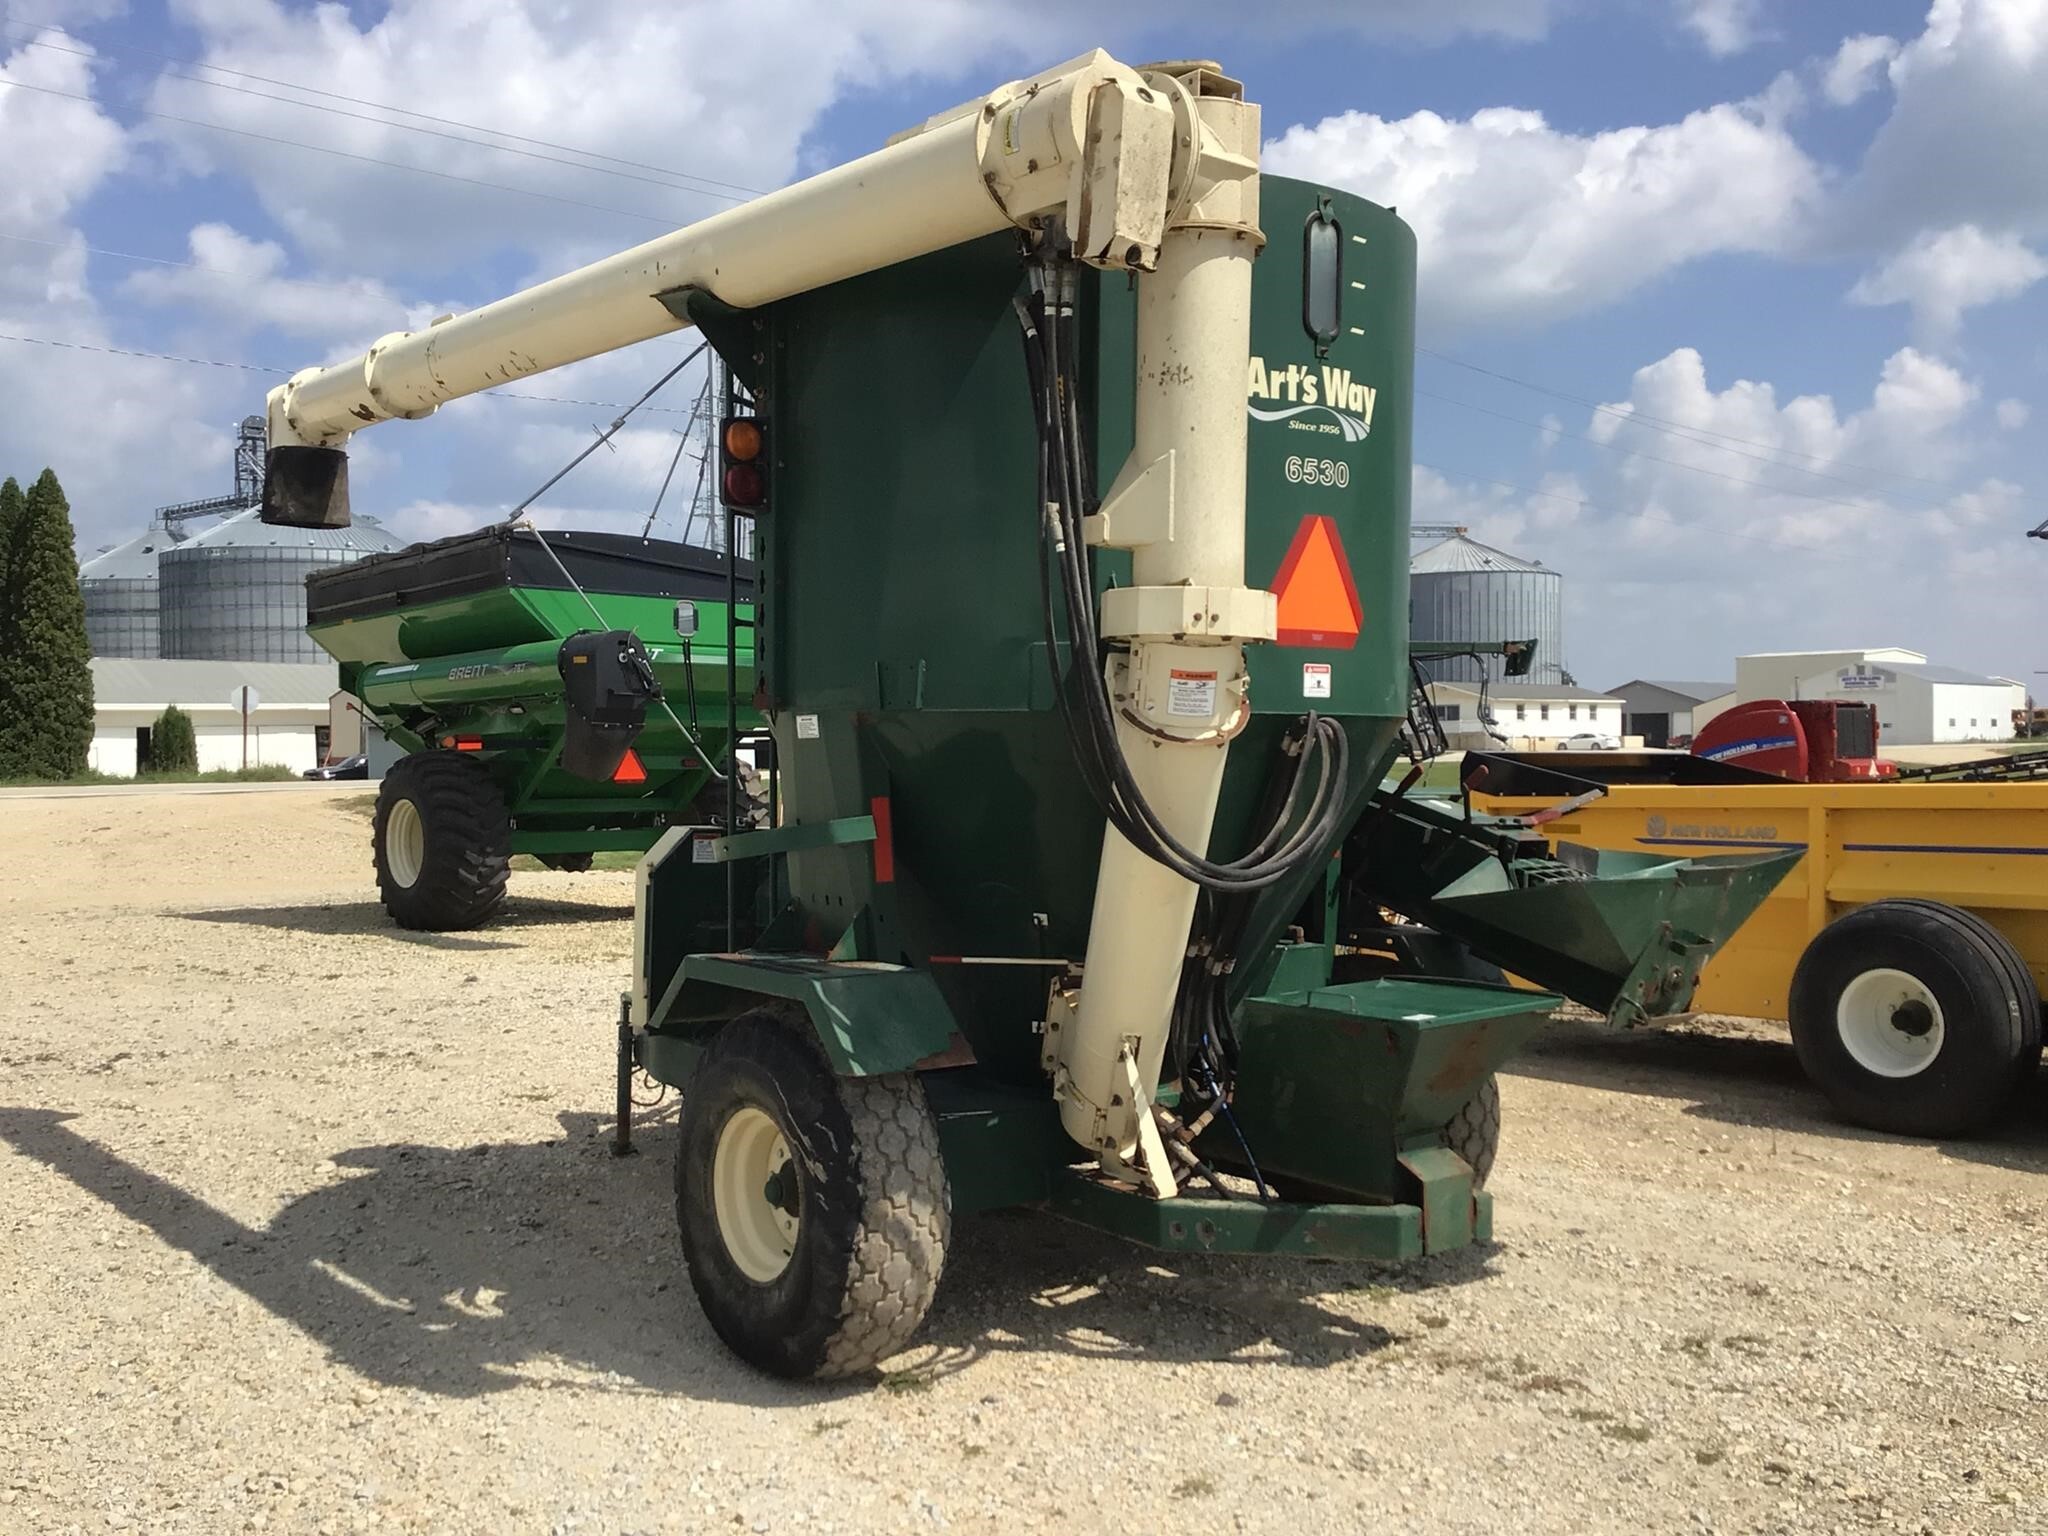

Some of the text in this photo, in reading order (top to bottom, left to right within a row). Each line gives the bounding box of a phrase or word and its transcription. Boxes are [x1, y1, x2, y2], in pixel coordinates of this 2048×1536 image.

[1249, 356, 1377, 426] Art's Way
[1288, 419, 1341, 436] Since 1956
[1285, 455, 1350, 488] 6530
[448, 663, 489, 681] BRENT
[1722, 743, 1758, 759] HOLLAND
[1704, 825, 1778, 840] HOLLAND
